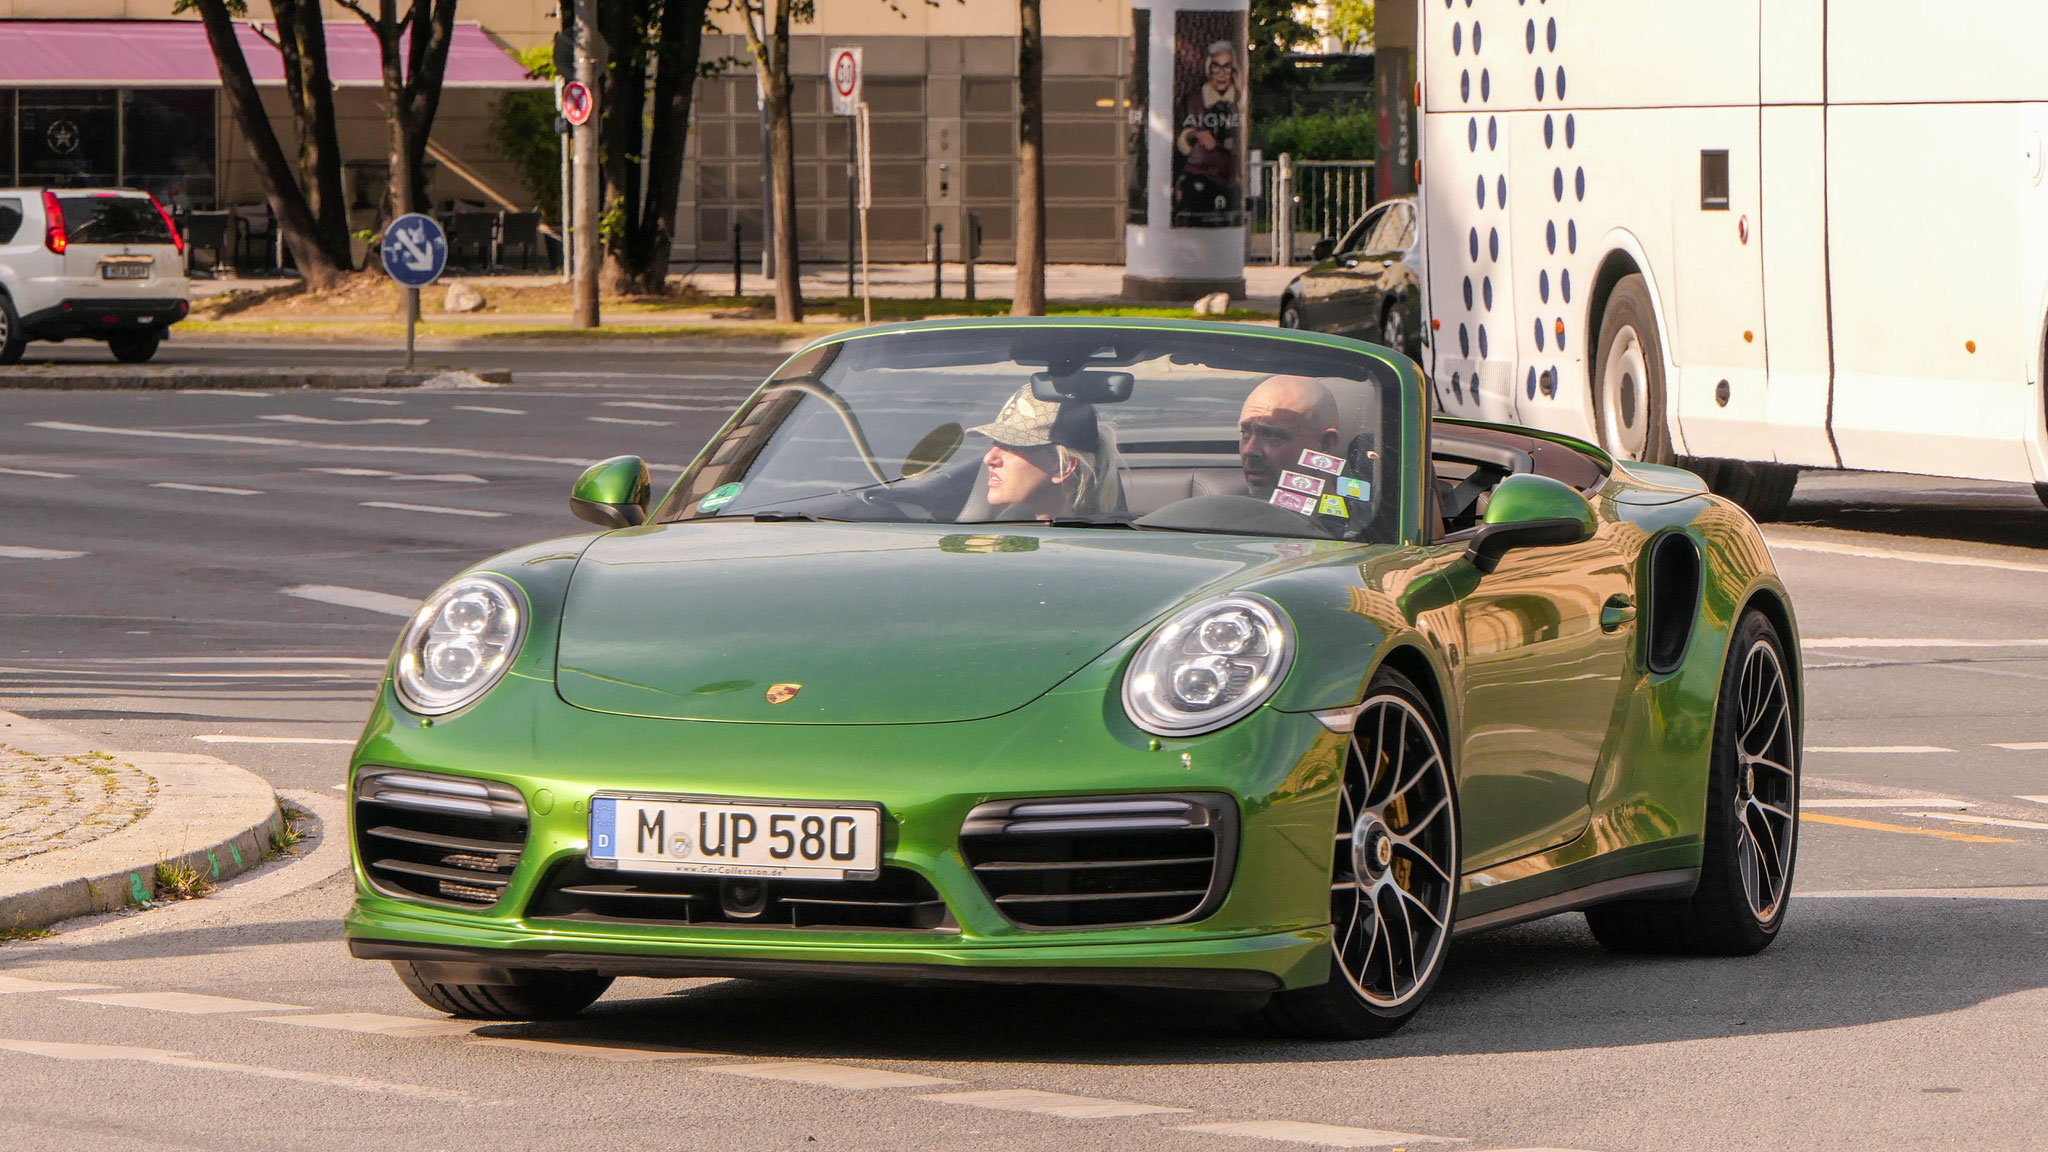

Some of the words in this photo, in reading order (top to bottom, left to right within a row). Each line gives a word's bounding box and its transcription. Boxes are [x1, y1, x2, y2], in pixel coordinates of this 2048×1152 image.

[598, 834, 609, 847] D
[637, 808, 664, 854] M
[699, 811, 757, 857] UP
[769, 814, 855, 860] 580
